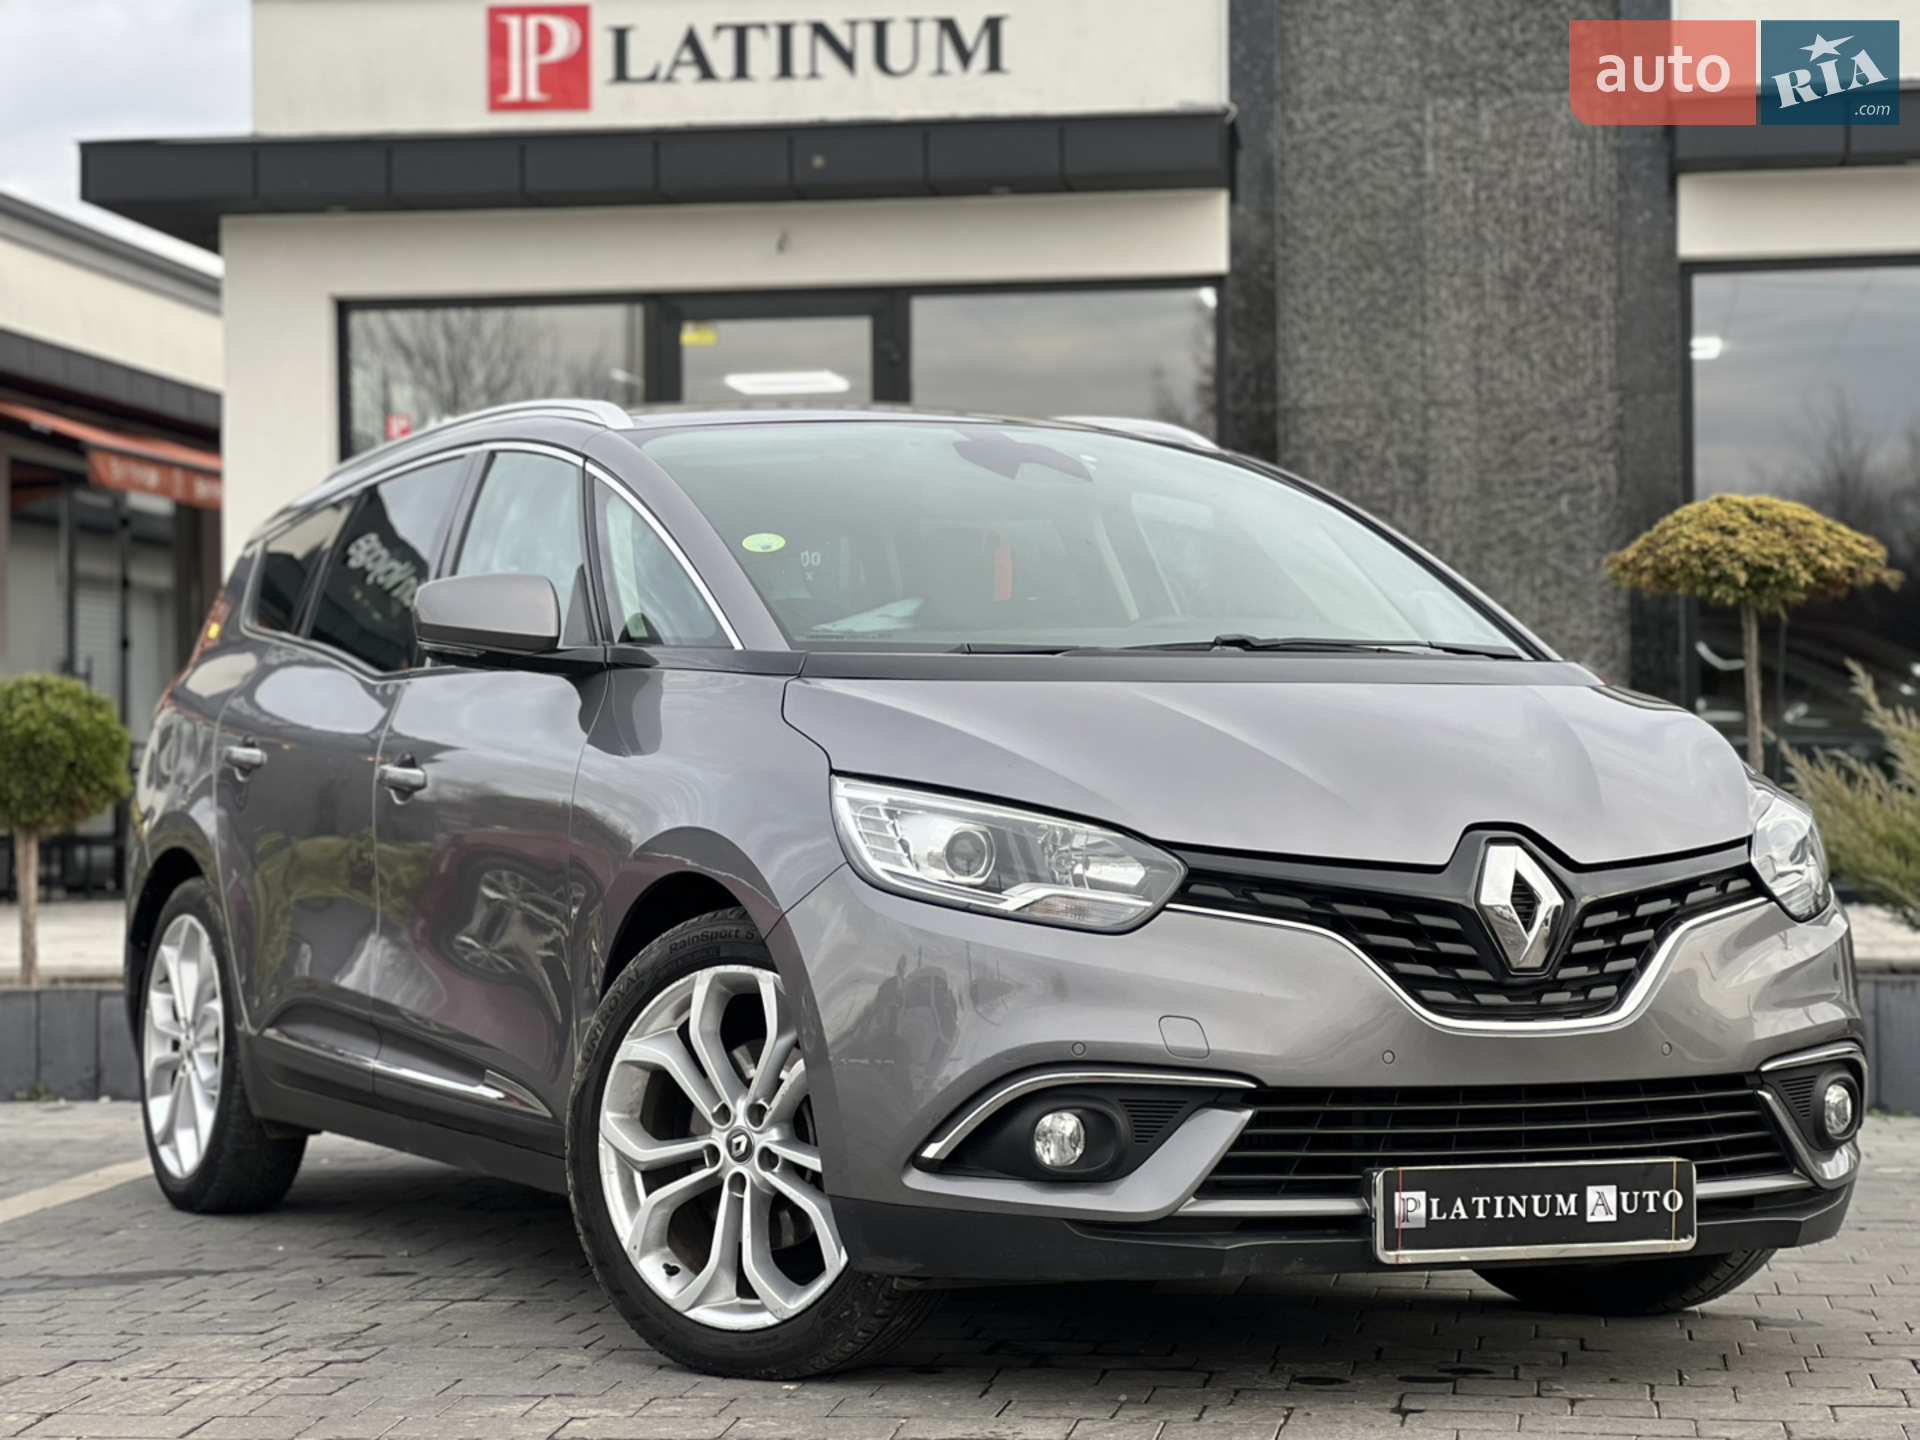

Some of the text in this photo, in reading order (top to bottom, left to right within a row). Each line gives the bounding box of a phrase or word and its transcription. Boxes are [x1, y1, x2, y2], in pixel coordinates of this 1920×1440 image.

[495, 13, 1010, 103] PLATINUM
[669, 928, 740, 955] RainSport
[1398, 1189, 1685, 1224] PLATINUM AUTO
